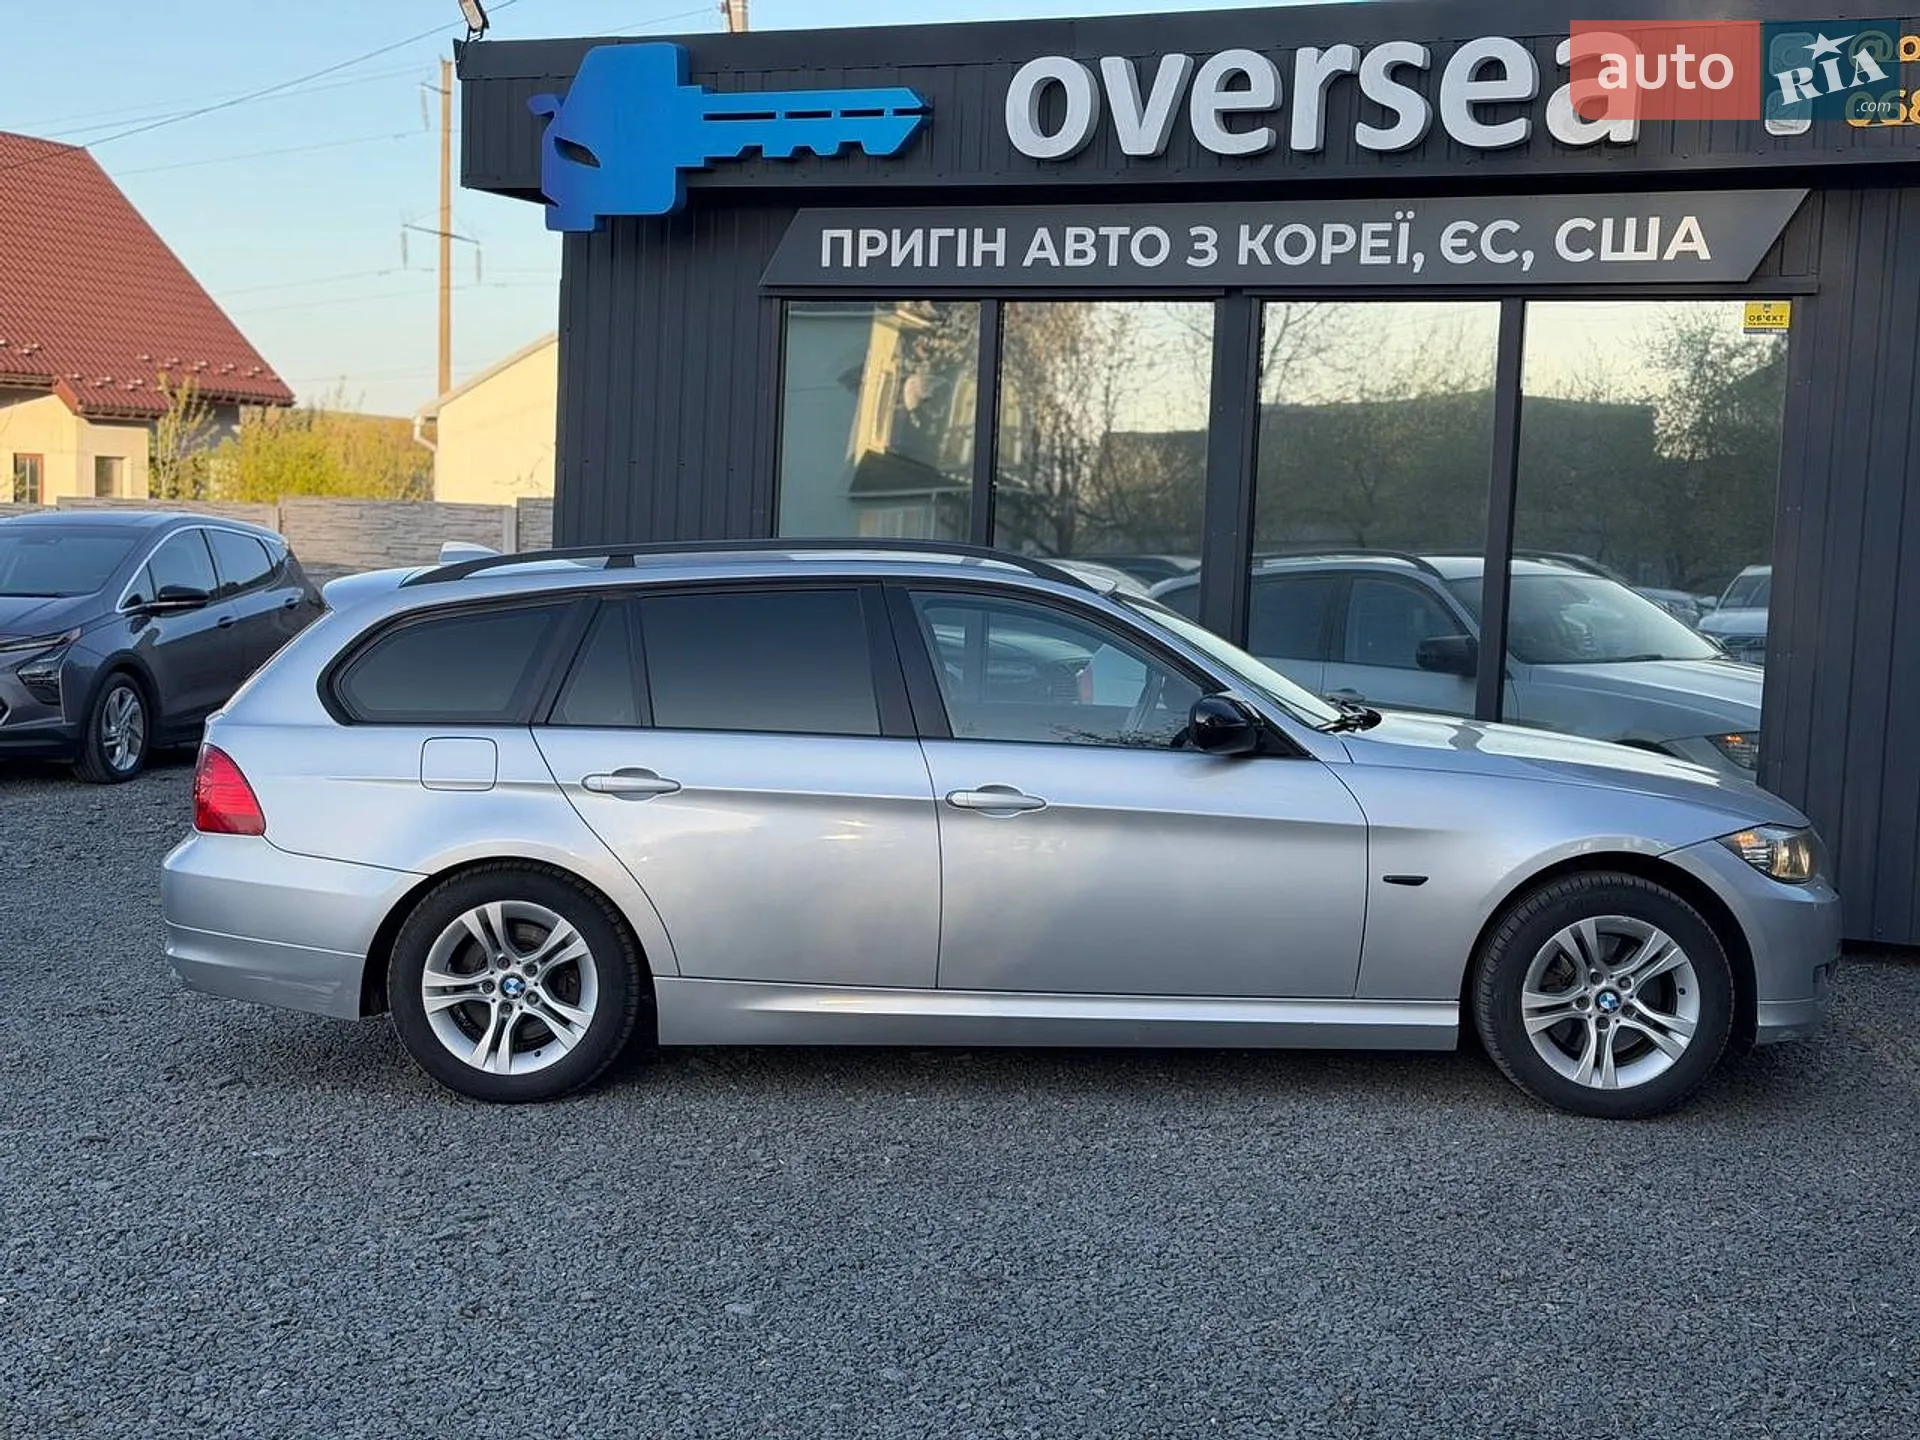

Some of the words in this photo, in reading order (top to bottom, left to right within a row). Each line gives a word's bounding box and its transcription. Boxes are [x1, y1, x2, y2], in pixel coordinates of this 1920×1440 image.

[1005, 31, 1640, 159] oversea
[821, 228, 1006, 267] ПРИГІН
[1022, 226, 1171, 267] АВТО
[1237, 210, 1425, 273] КОРЕЇ,
[1439, 220, 1535, 272] ЄС,
[1555, 215, 1712, 263] США
